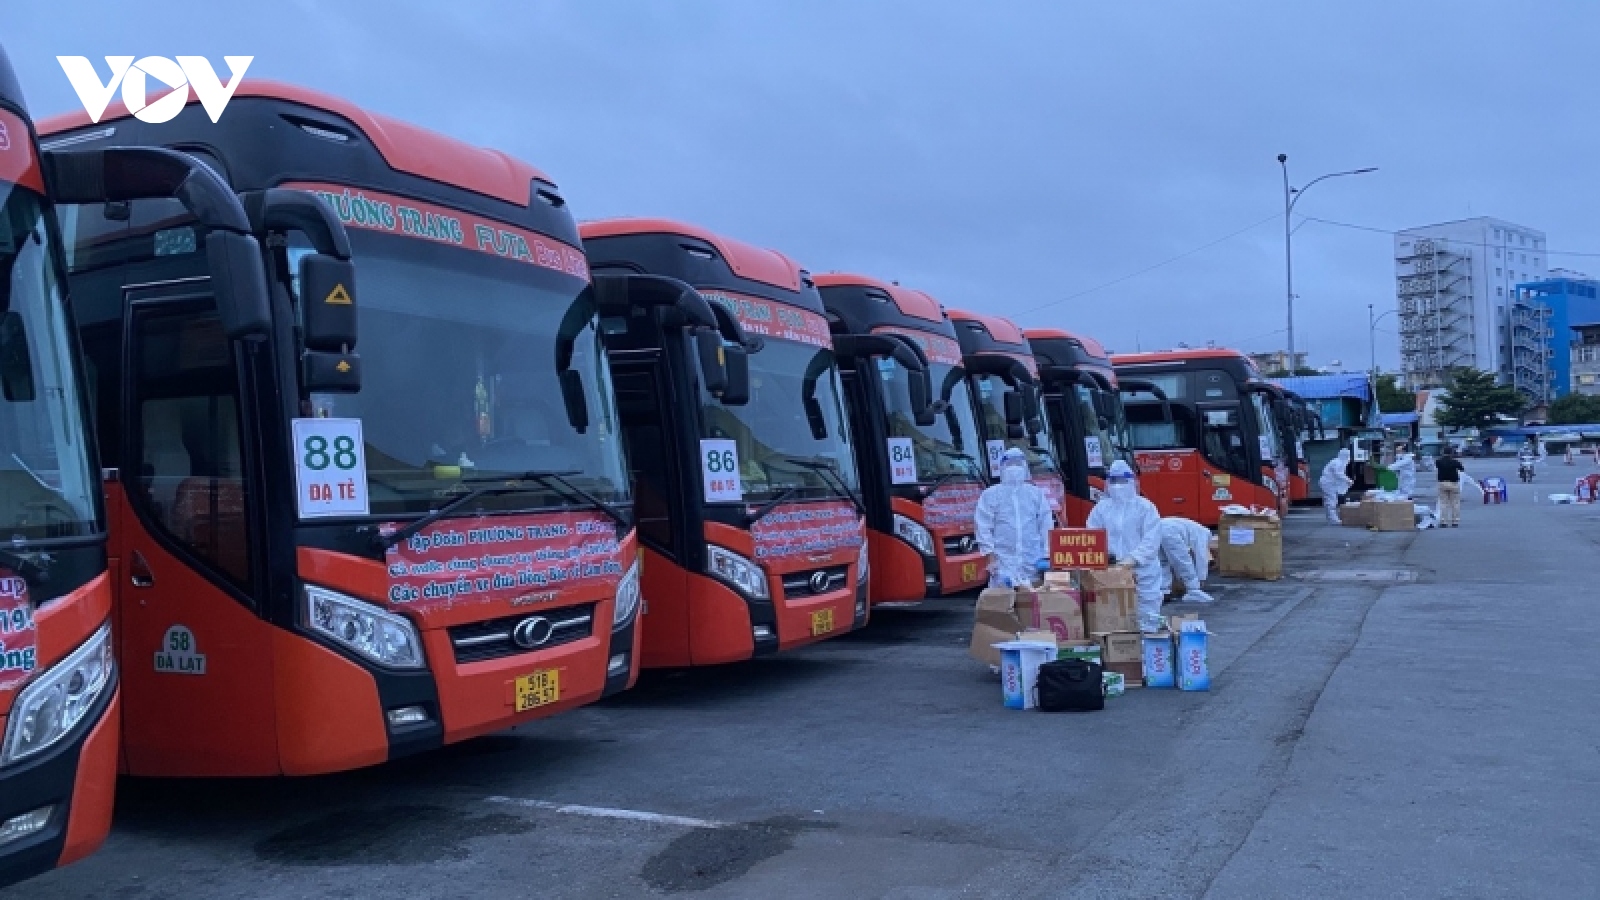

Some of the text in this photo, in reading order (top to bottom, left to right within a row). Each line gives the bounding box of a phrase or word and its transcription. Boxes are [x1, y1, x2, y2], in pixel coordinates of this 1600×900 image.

[316, 188, 395, 230] HƯƠNG
[396, 206, 464, 245] TRANG
[474, 224, 534, 263] FUTA
[303, 435, 357, 470] 88
[707, 449, 735, 473] 86
[892, 445, 913, 462] 84
[526, 523, 568, 540] TRANG
[1059, 533, 1097, 547] HUYỆN
[388, 581, 420, 603] Các
[169, 631, 191, 652] 58
